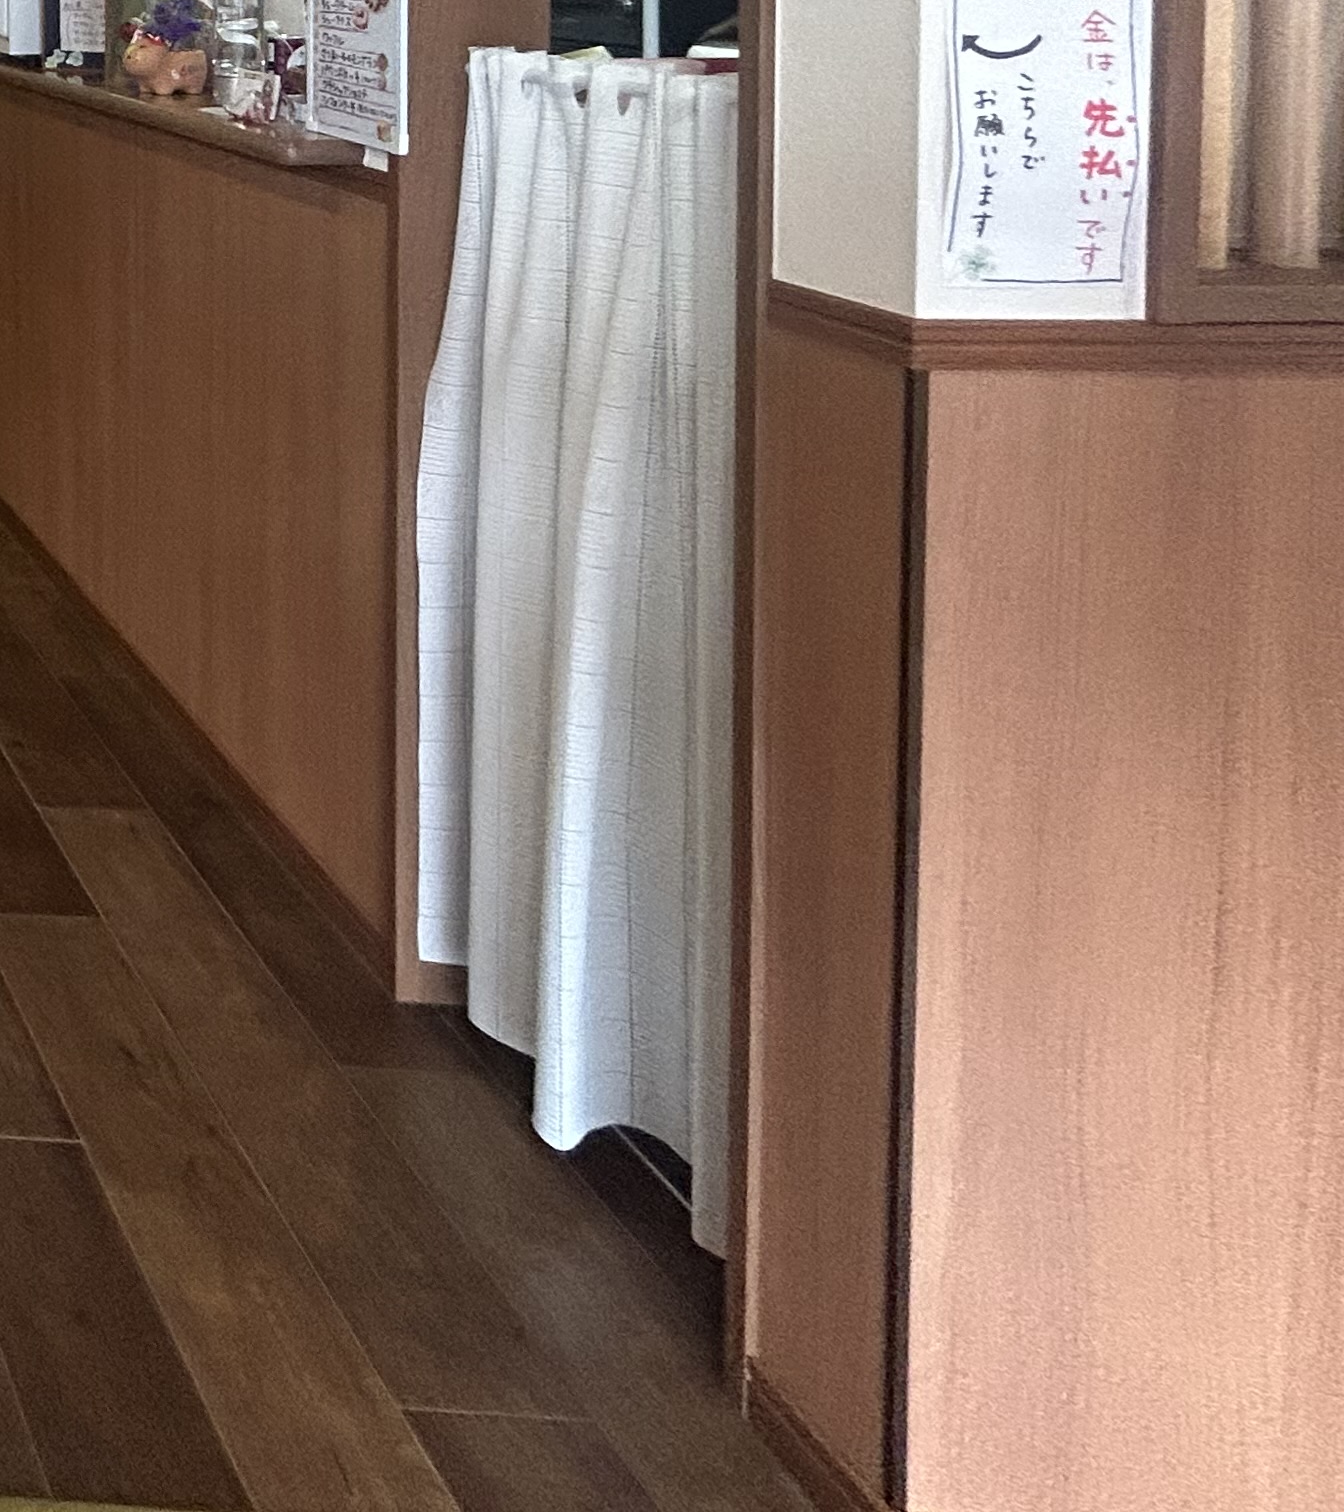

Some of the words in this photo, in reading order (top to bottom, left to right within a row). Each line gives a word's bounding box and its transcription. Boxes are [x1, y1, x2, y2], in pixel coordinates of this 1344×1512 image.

[971, 90, 1005, 239] お願いします
[1016, 73, 1046, 170] こちらで
